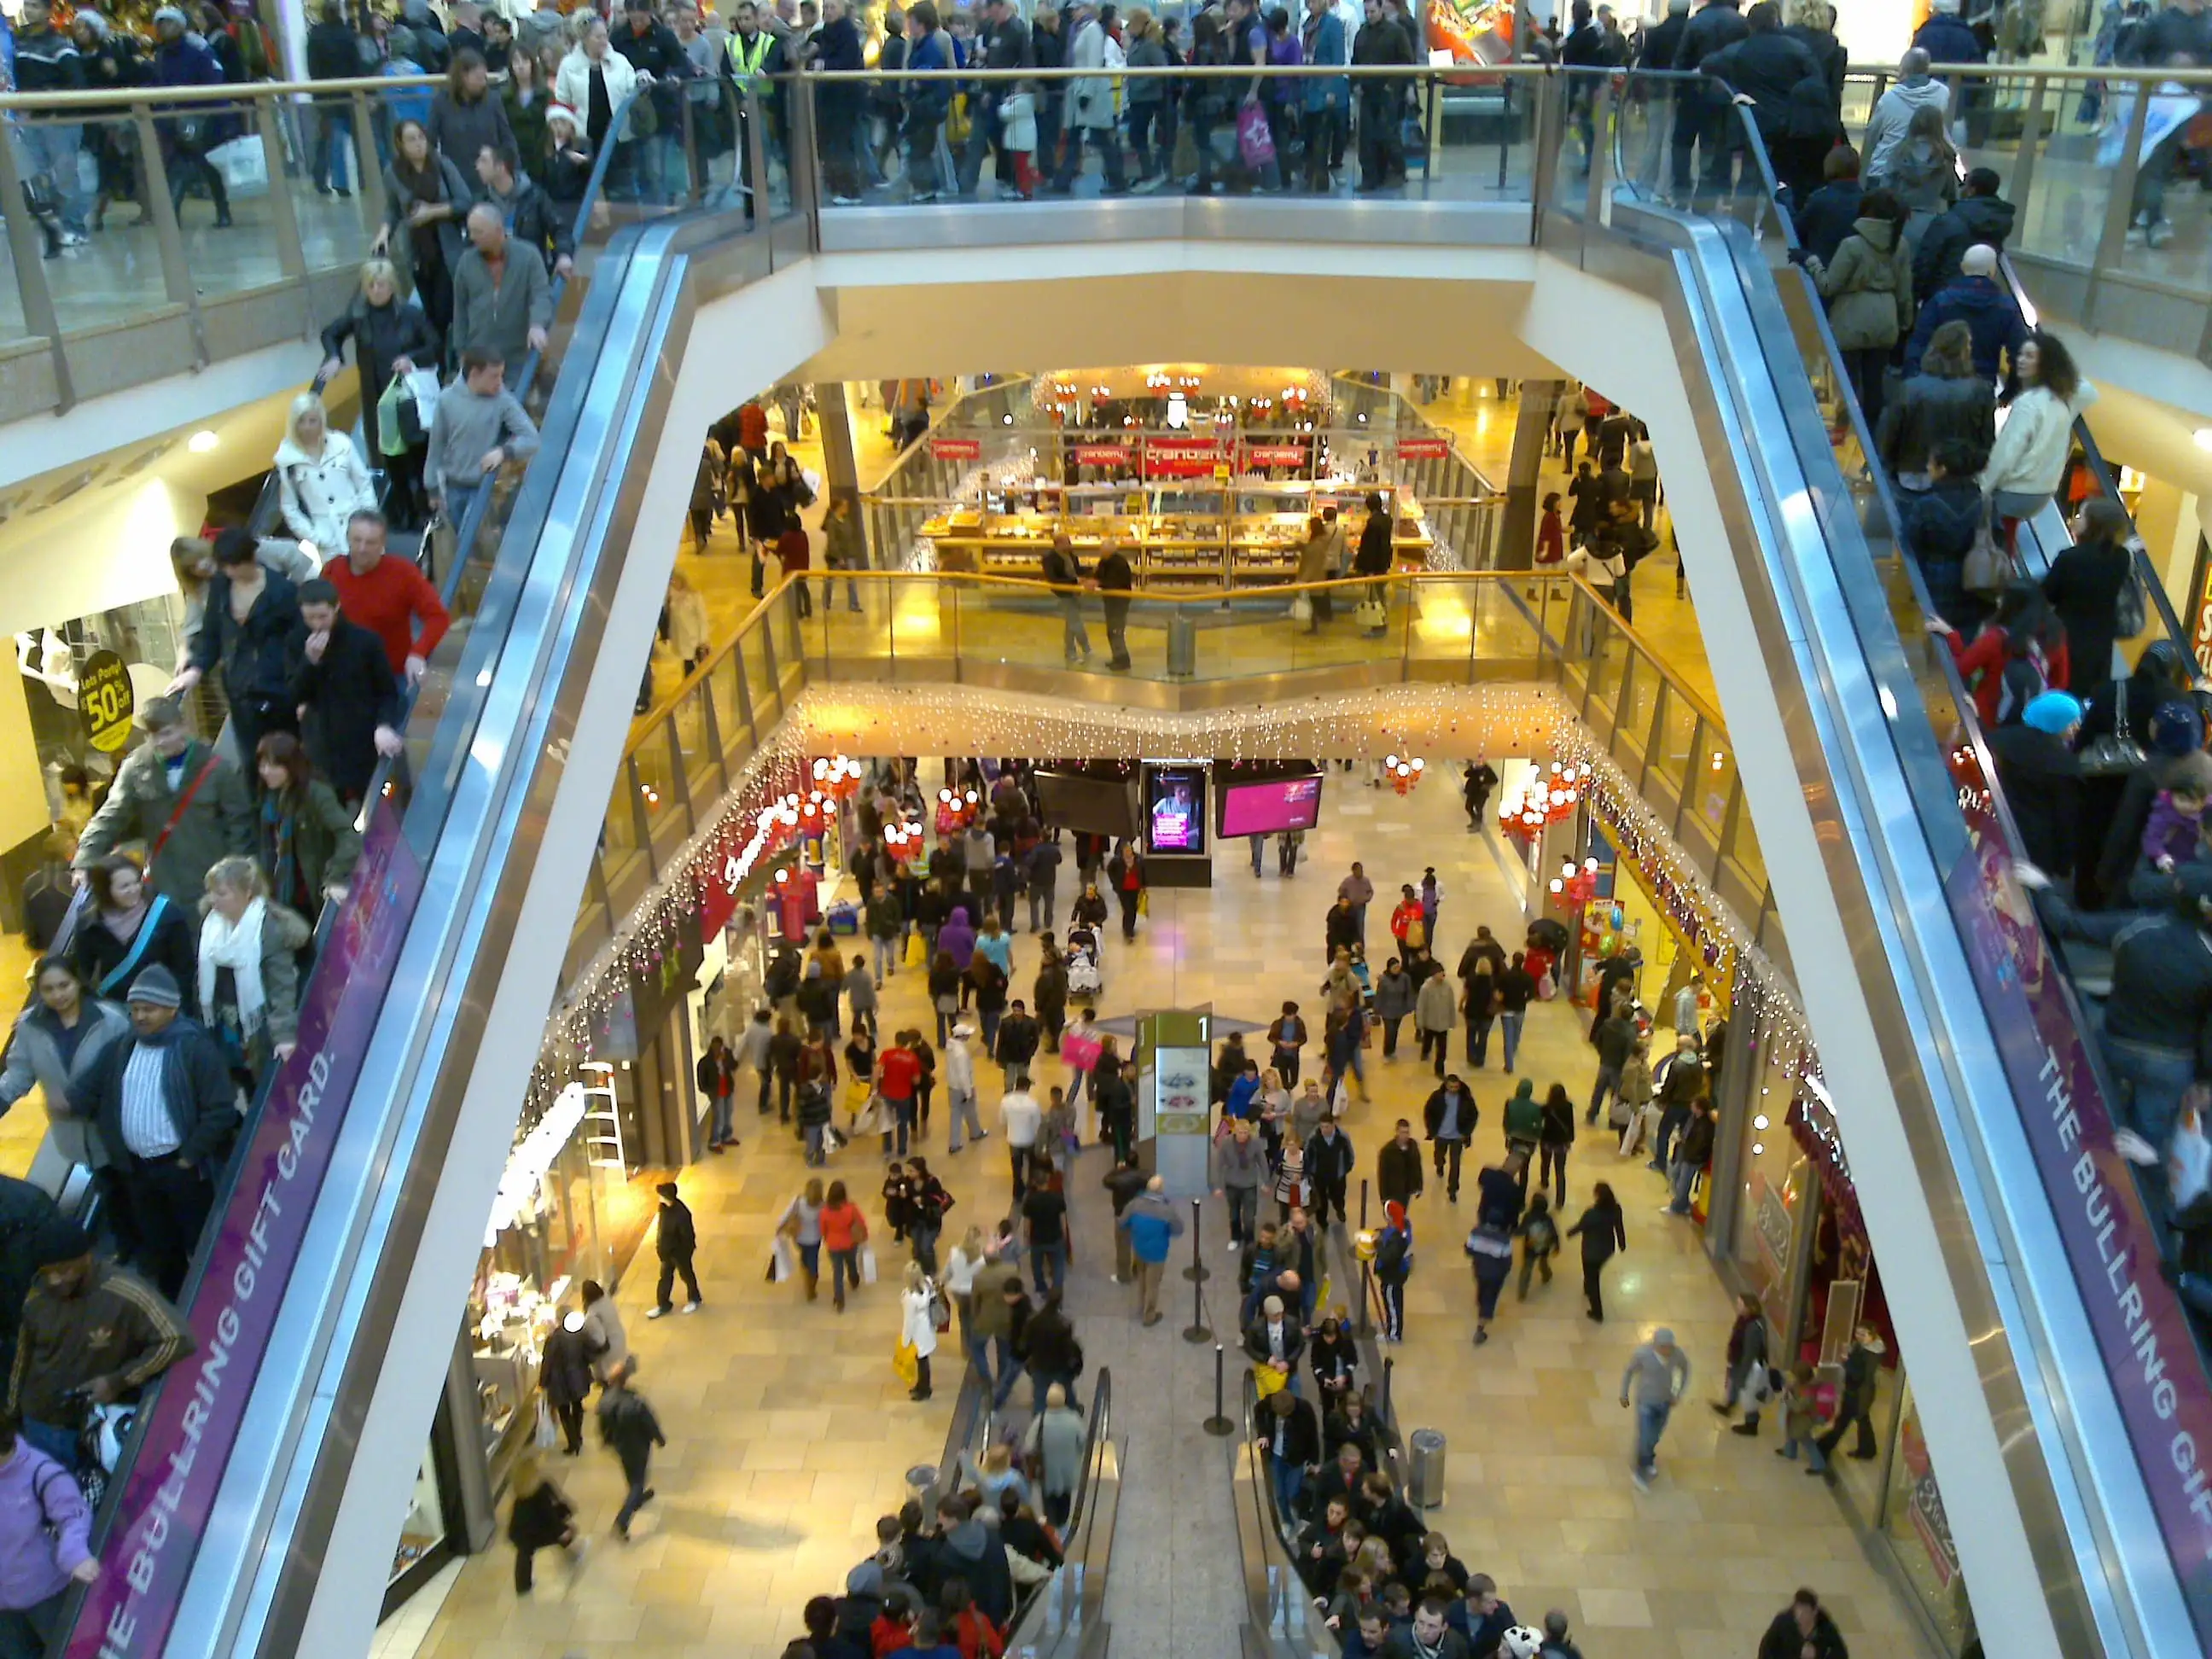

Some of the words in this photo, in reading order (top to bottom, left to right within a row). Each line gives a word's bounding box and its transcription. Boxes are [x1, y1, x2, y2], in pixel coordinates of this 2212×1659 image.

[1198, 1016, 1208, 1042] 1
[127, 1306, 240, 1594] BULLRING
[233, 1180, 282, 1301] GIFT
[276, 1051, 335, 1181] CARD.
[2039, 1045, 2082, 1152] THE
[2072, 1150, 2177, 1420] BULLRING
